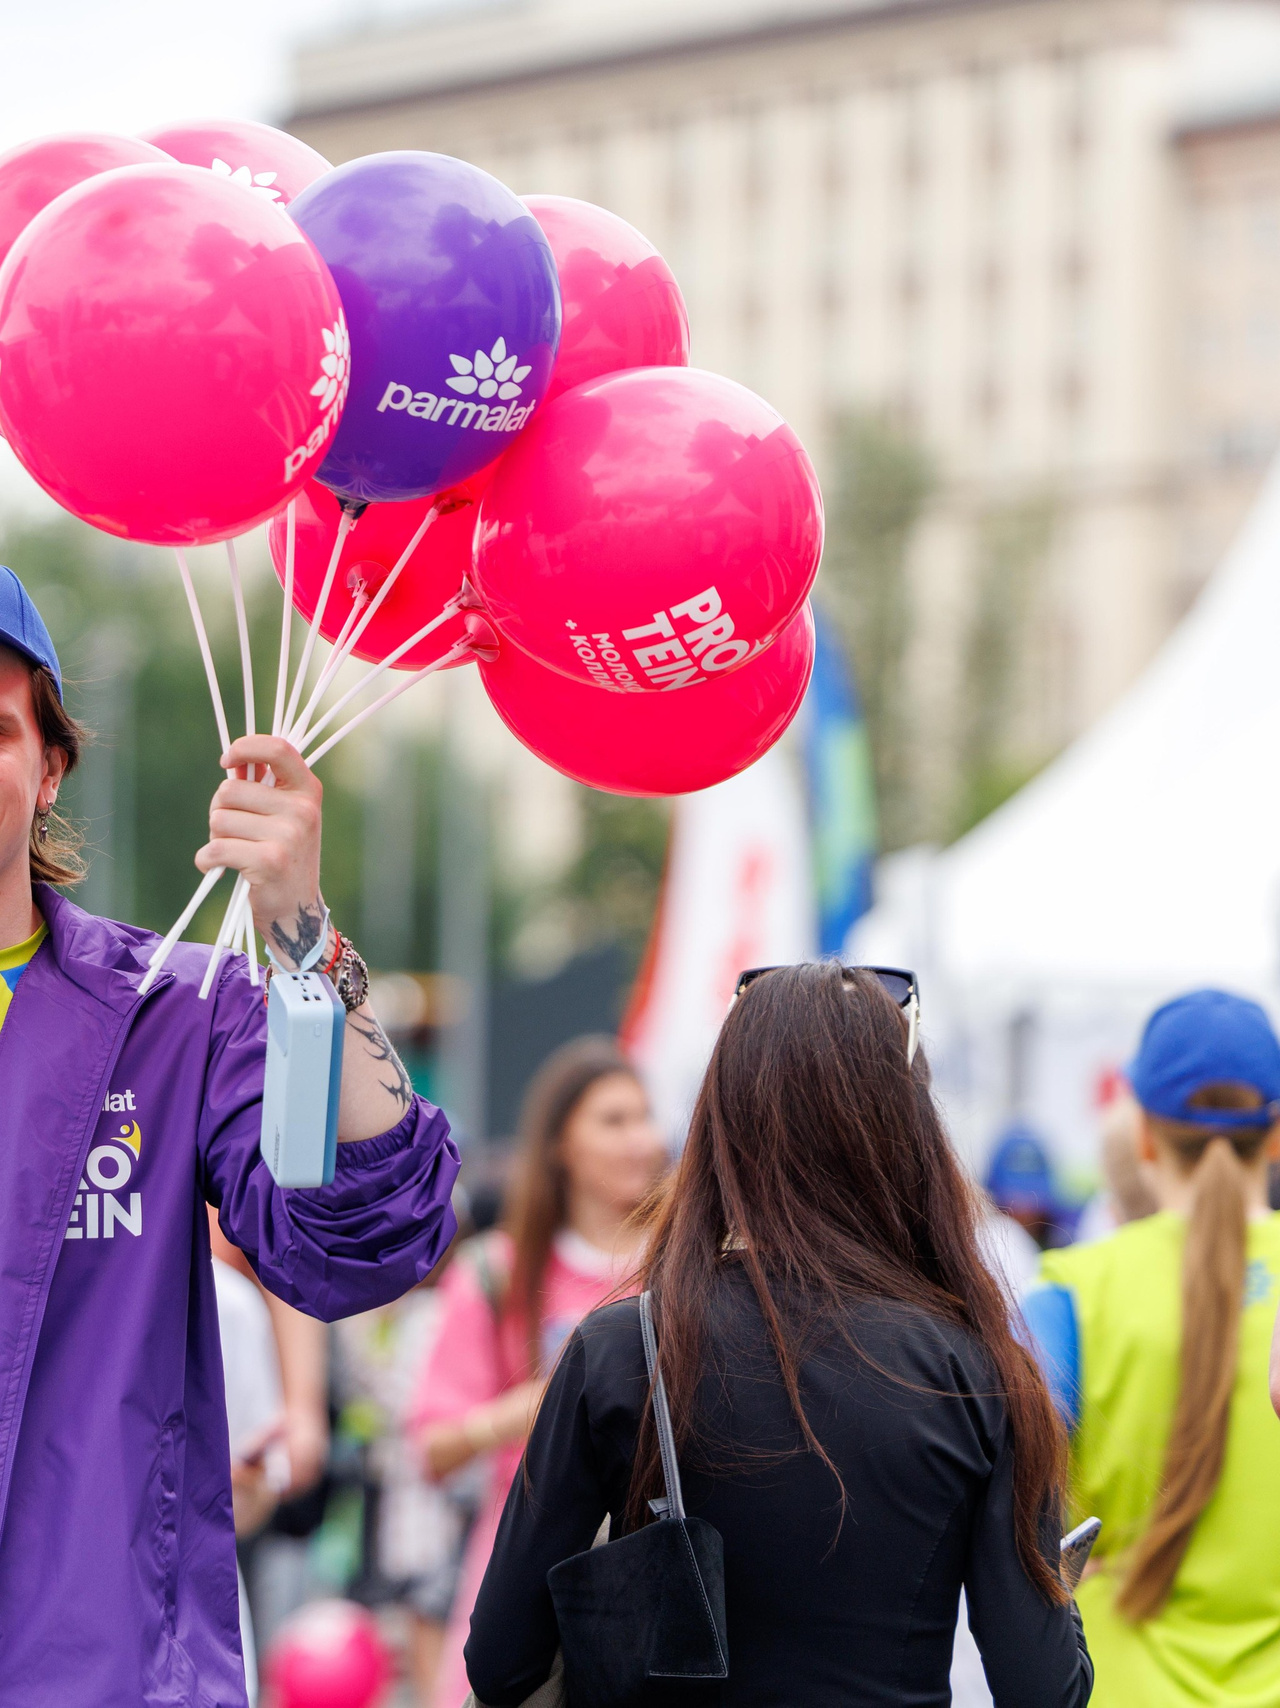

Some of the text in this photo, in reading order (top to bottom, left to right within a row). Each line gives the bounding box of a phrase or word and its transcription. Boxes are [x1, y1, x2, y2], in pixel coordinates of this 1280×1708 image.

[376, 381, 535, 432] parmalat
[621, 610, 709, 692] TEIN
[669, 585, 750, 672] PRO
